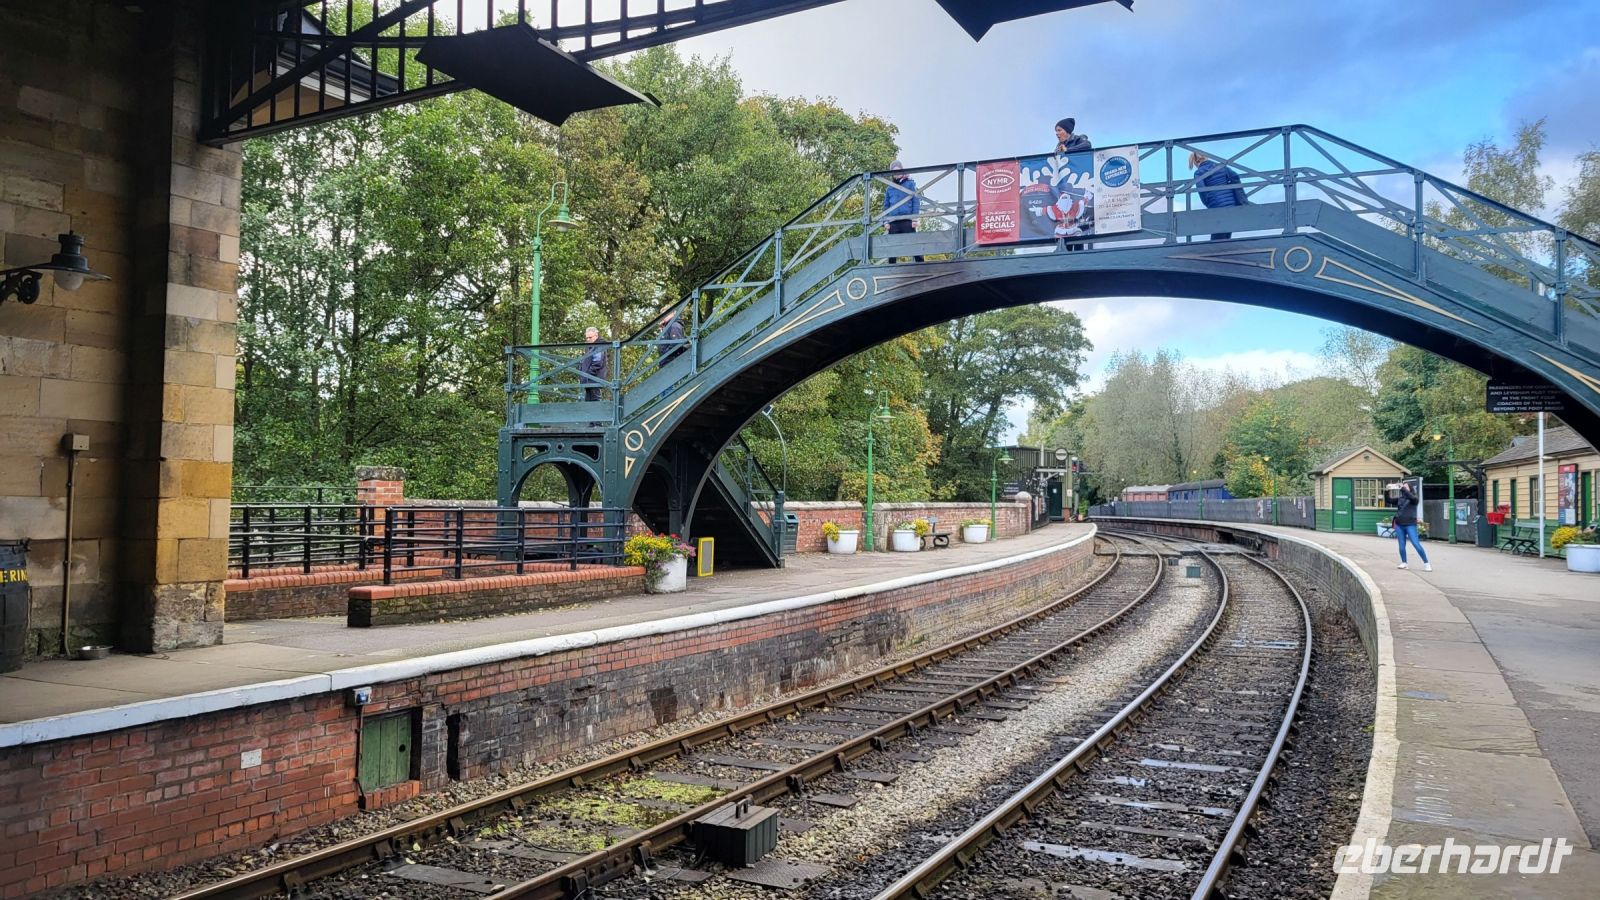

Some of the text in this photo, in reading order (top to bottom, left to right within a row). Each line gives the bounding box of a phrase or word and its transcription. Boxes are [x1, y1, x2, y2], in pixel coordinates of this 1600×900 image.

[987, 177, 1008, 185] NYMR
[985, 214, 1011, 223] SANTA
[980, 220, 1016, 230] SPECIALS
